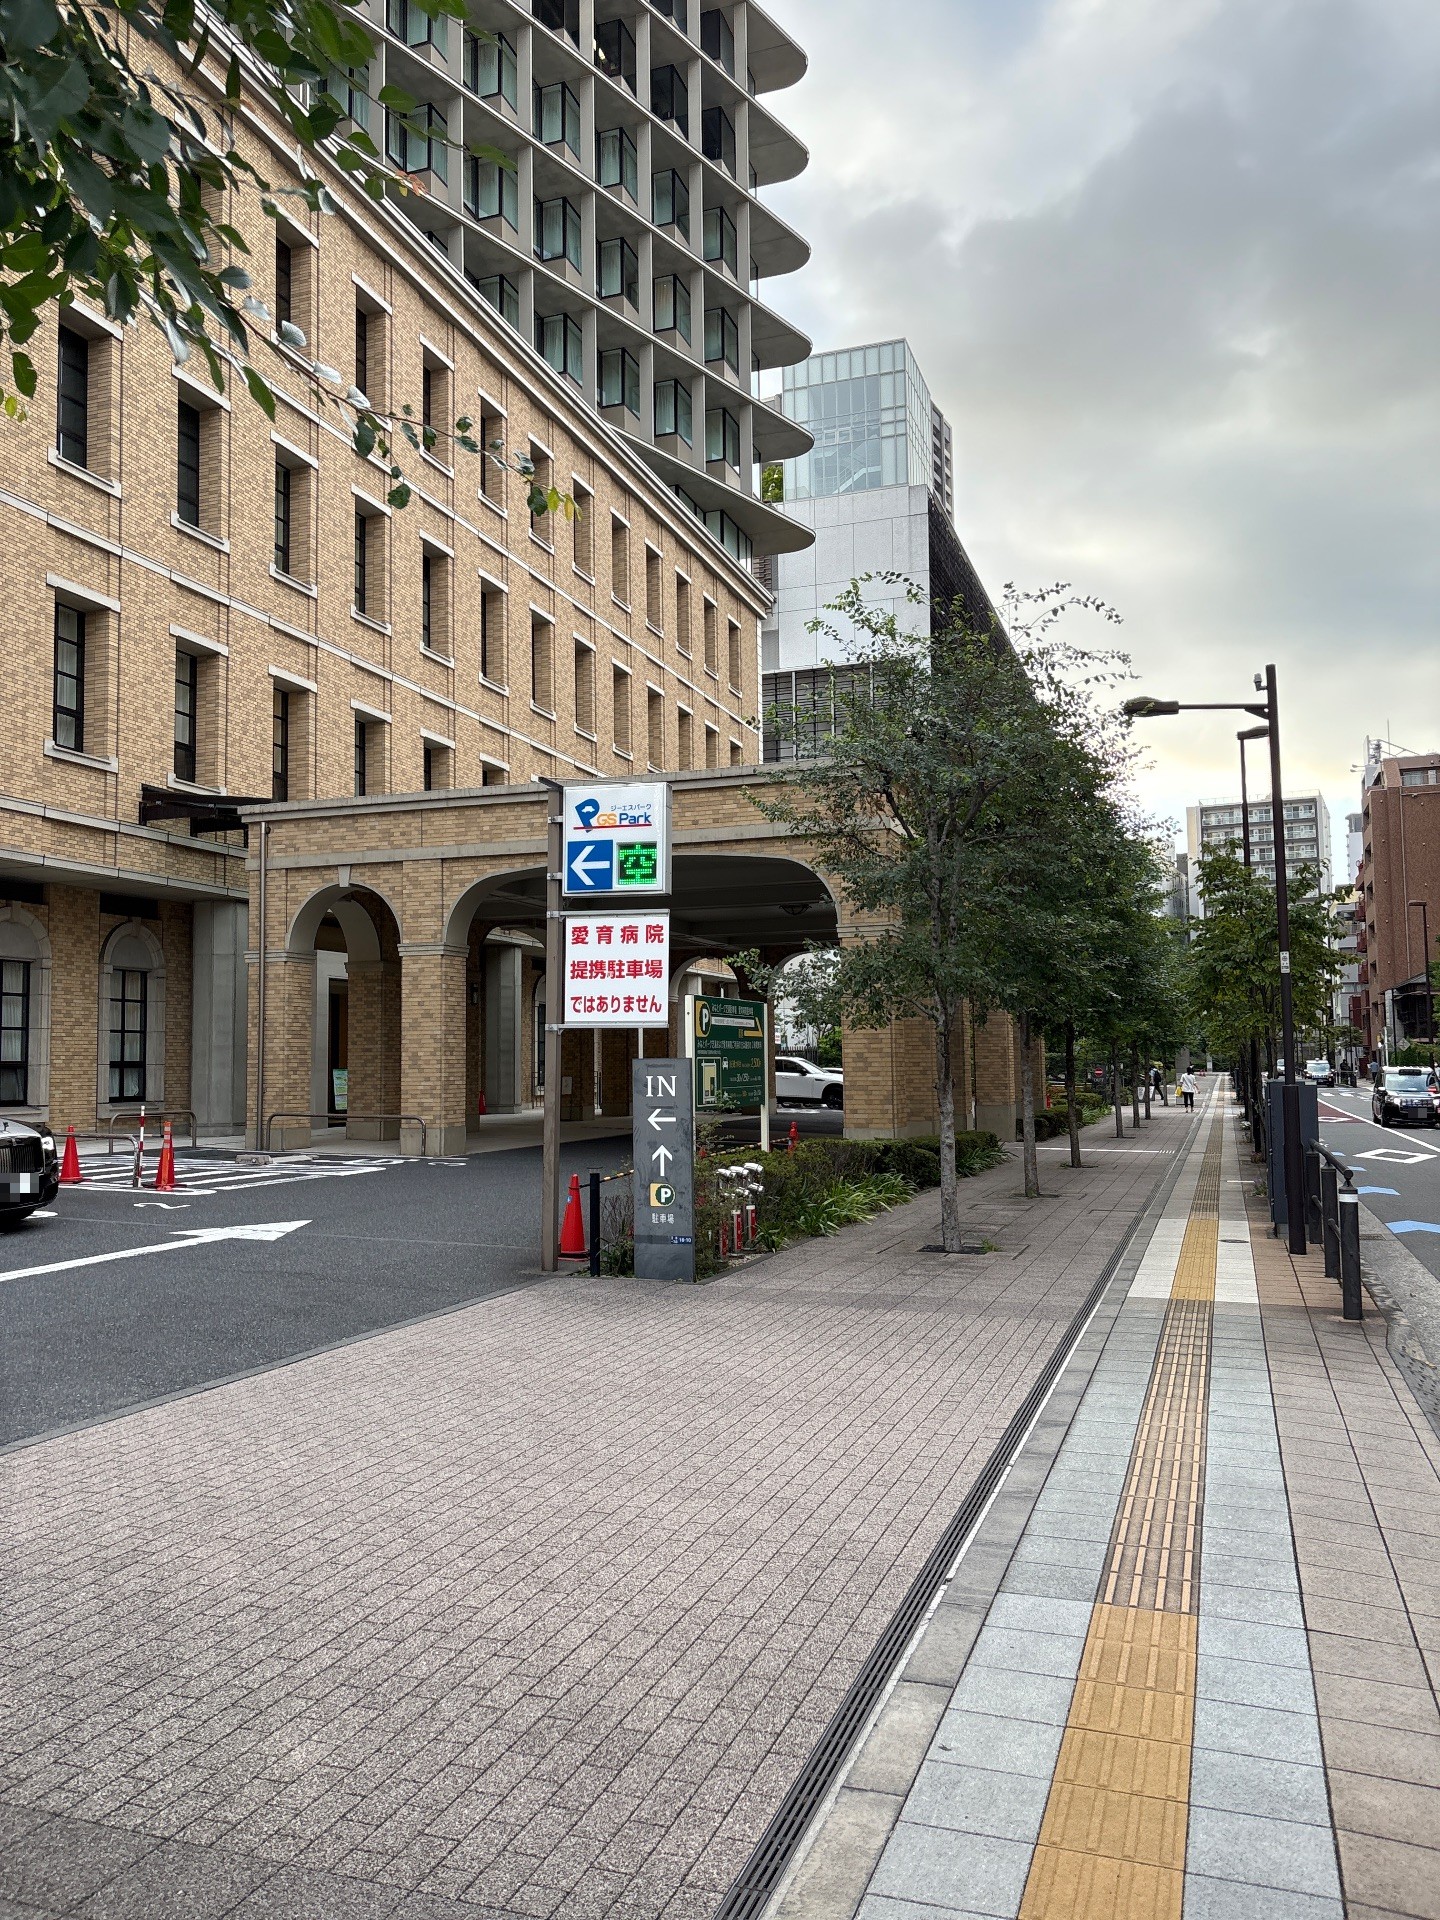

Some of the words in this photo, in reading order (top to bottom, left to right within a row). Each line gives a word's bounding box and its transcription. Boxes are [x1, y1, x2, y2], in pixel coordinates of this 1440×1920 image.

[610, 803, 652, 811] ジーエスパーク
[596, 813, 617, 826] GS
[619, 812, 652, 825] Park
[619, 843, 657, 885] 空
[571, 924, 664, 945] 愛育病院
[570, 959, 664, 980] 提携駐車場
[570, 995, 663, 1014] ではありません
[645, 1075, 678, 1098] IN
[651, 1213, 675, 1225] 駐車場
